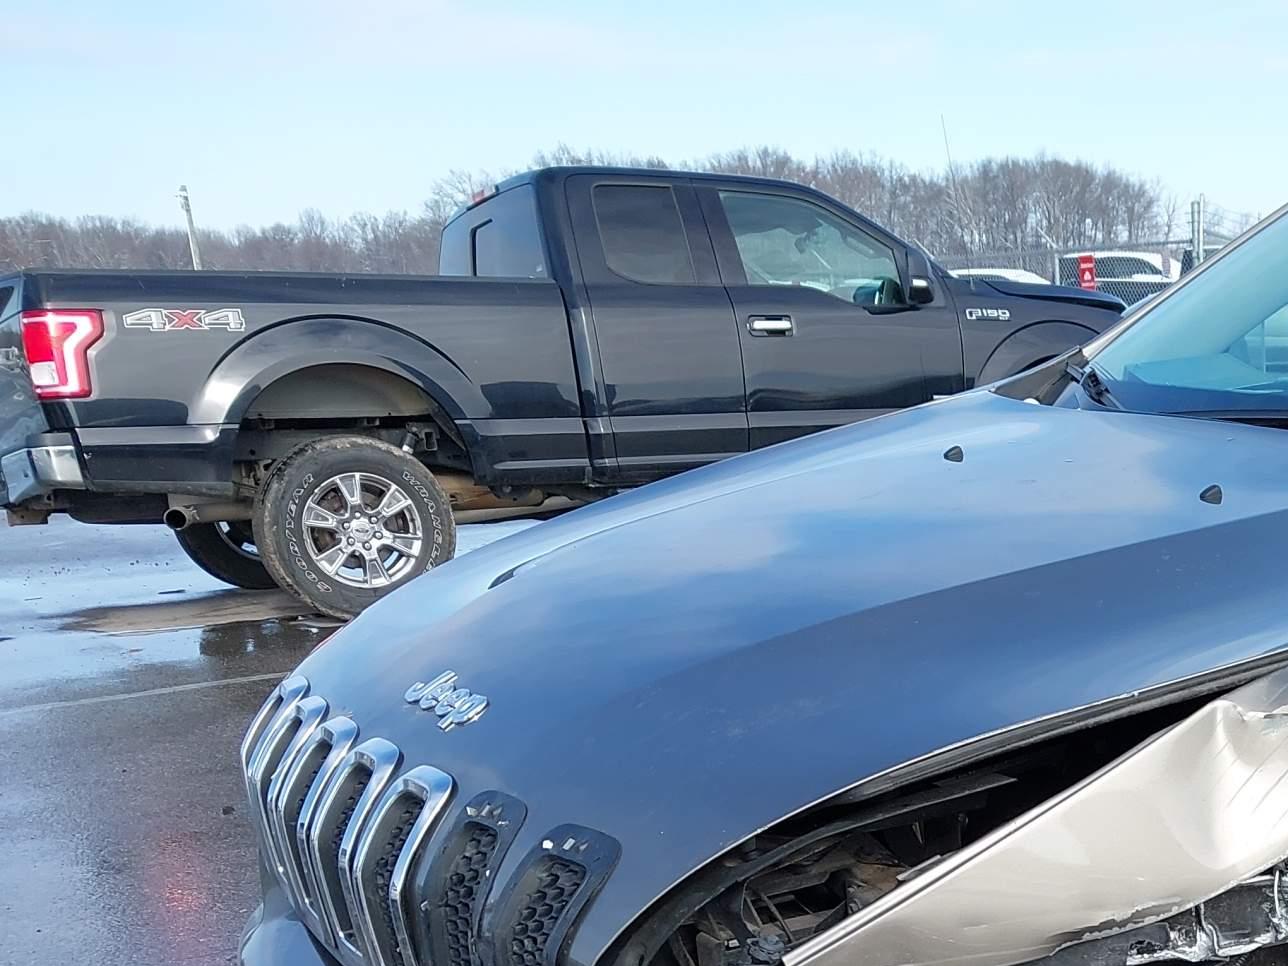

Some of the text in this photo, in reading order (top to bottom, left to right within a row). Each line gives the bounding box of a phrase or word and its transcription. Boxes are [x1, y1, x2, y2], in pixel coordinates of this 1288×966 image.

[285, 473, 333, 593] GOODYEAR
[402, 471, 443, 576] WRANGLE
[404, 669, 488, 732] Jeep
